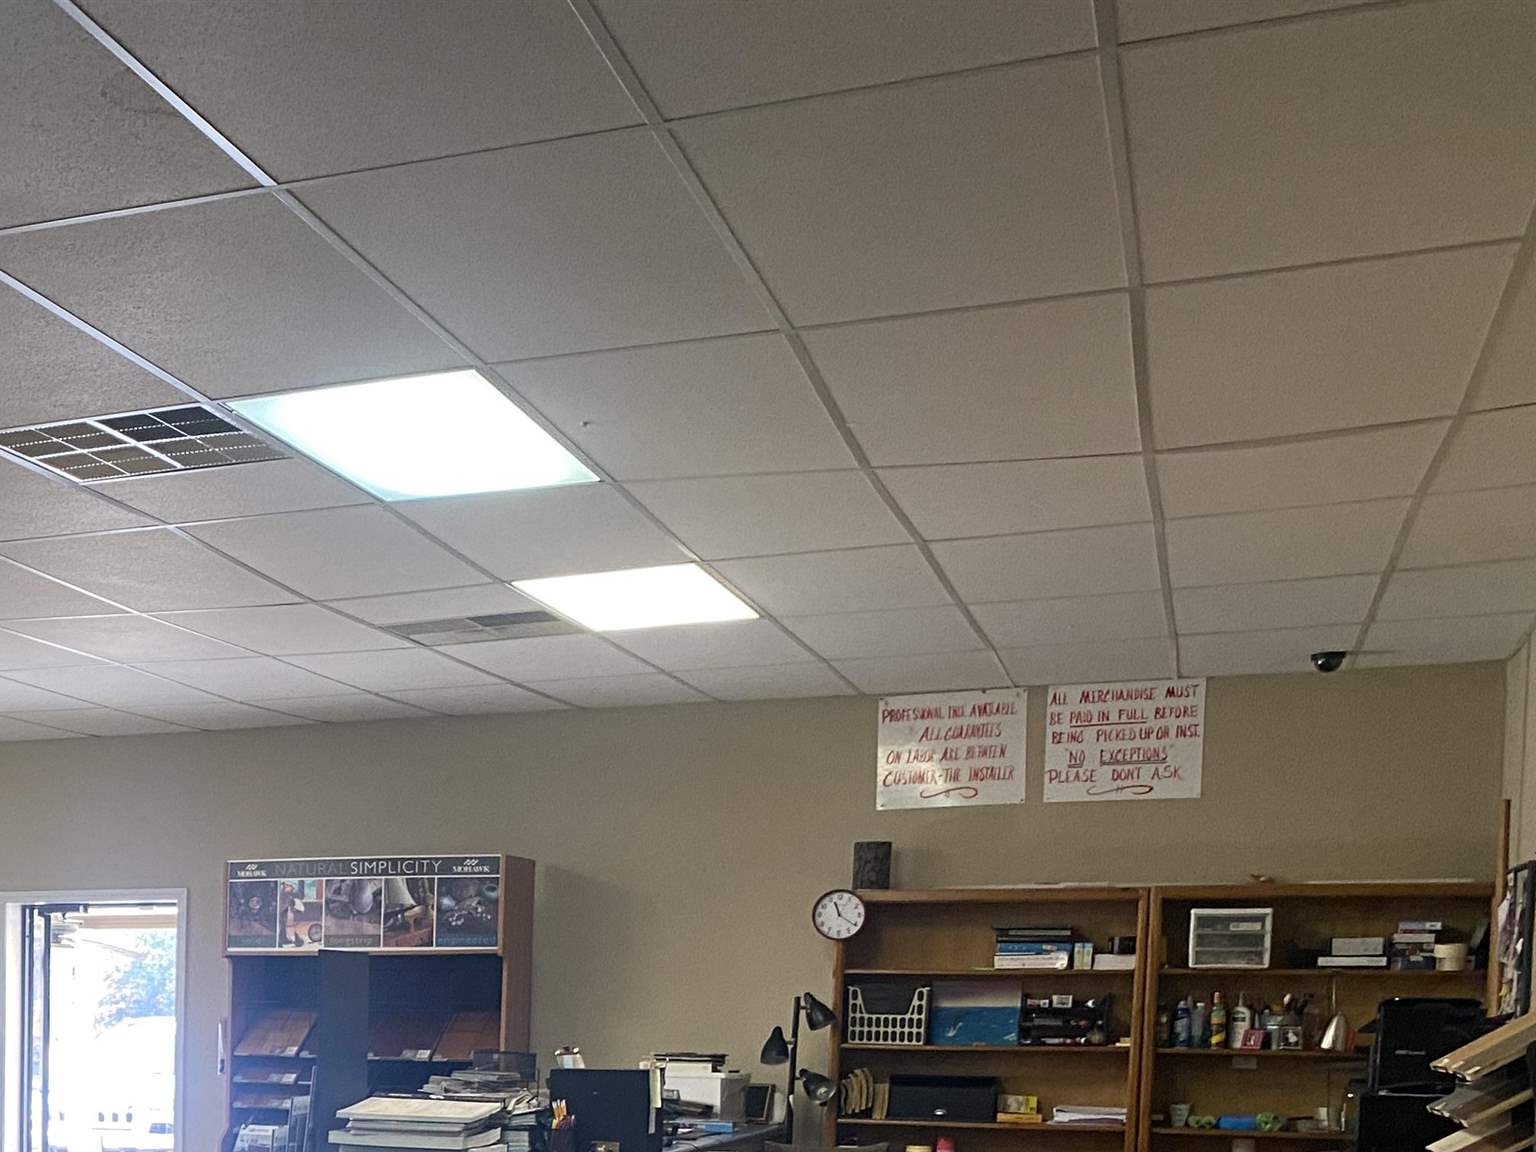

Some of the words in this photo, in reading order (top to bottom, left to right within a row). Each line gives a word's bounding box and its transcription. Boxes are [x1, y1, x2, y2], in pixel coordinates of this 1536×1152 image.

[1049, 691, 1069, 706] ALL
[1164, 683, 1200, 699] MUST
[1049, 712, 1063, 726] BE
[1069, 709, 1093, 725] PAID
[1097, 709, 1110, 722] IN
[1118, 708, 1148, 721] FULL
[1154, 704, 1199, 720] BEFORE
[1051, 730, 1084, 744] BEING
[1096, 728, 1136, 743] PICKED
[886, 749, 901, 765] ON
[1047, 768, 1096, 784] PLEASE
[1151, 764, 1182, 781] ASK
[272, 862, 347, 877] NATURAL
[350, 859, 442, 875] SIMPLICITY
[452, 865, 491, 873] MOHAWK
